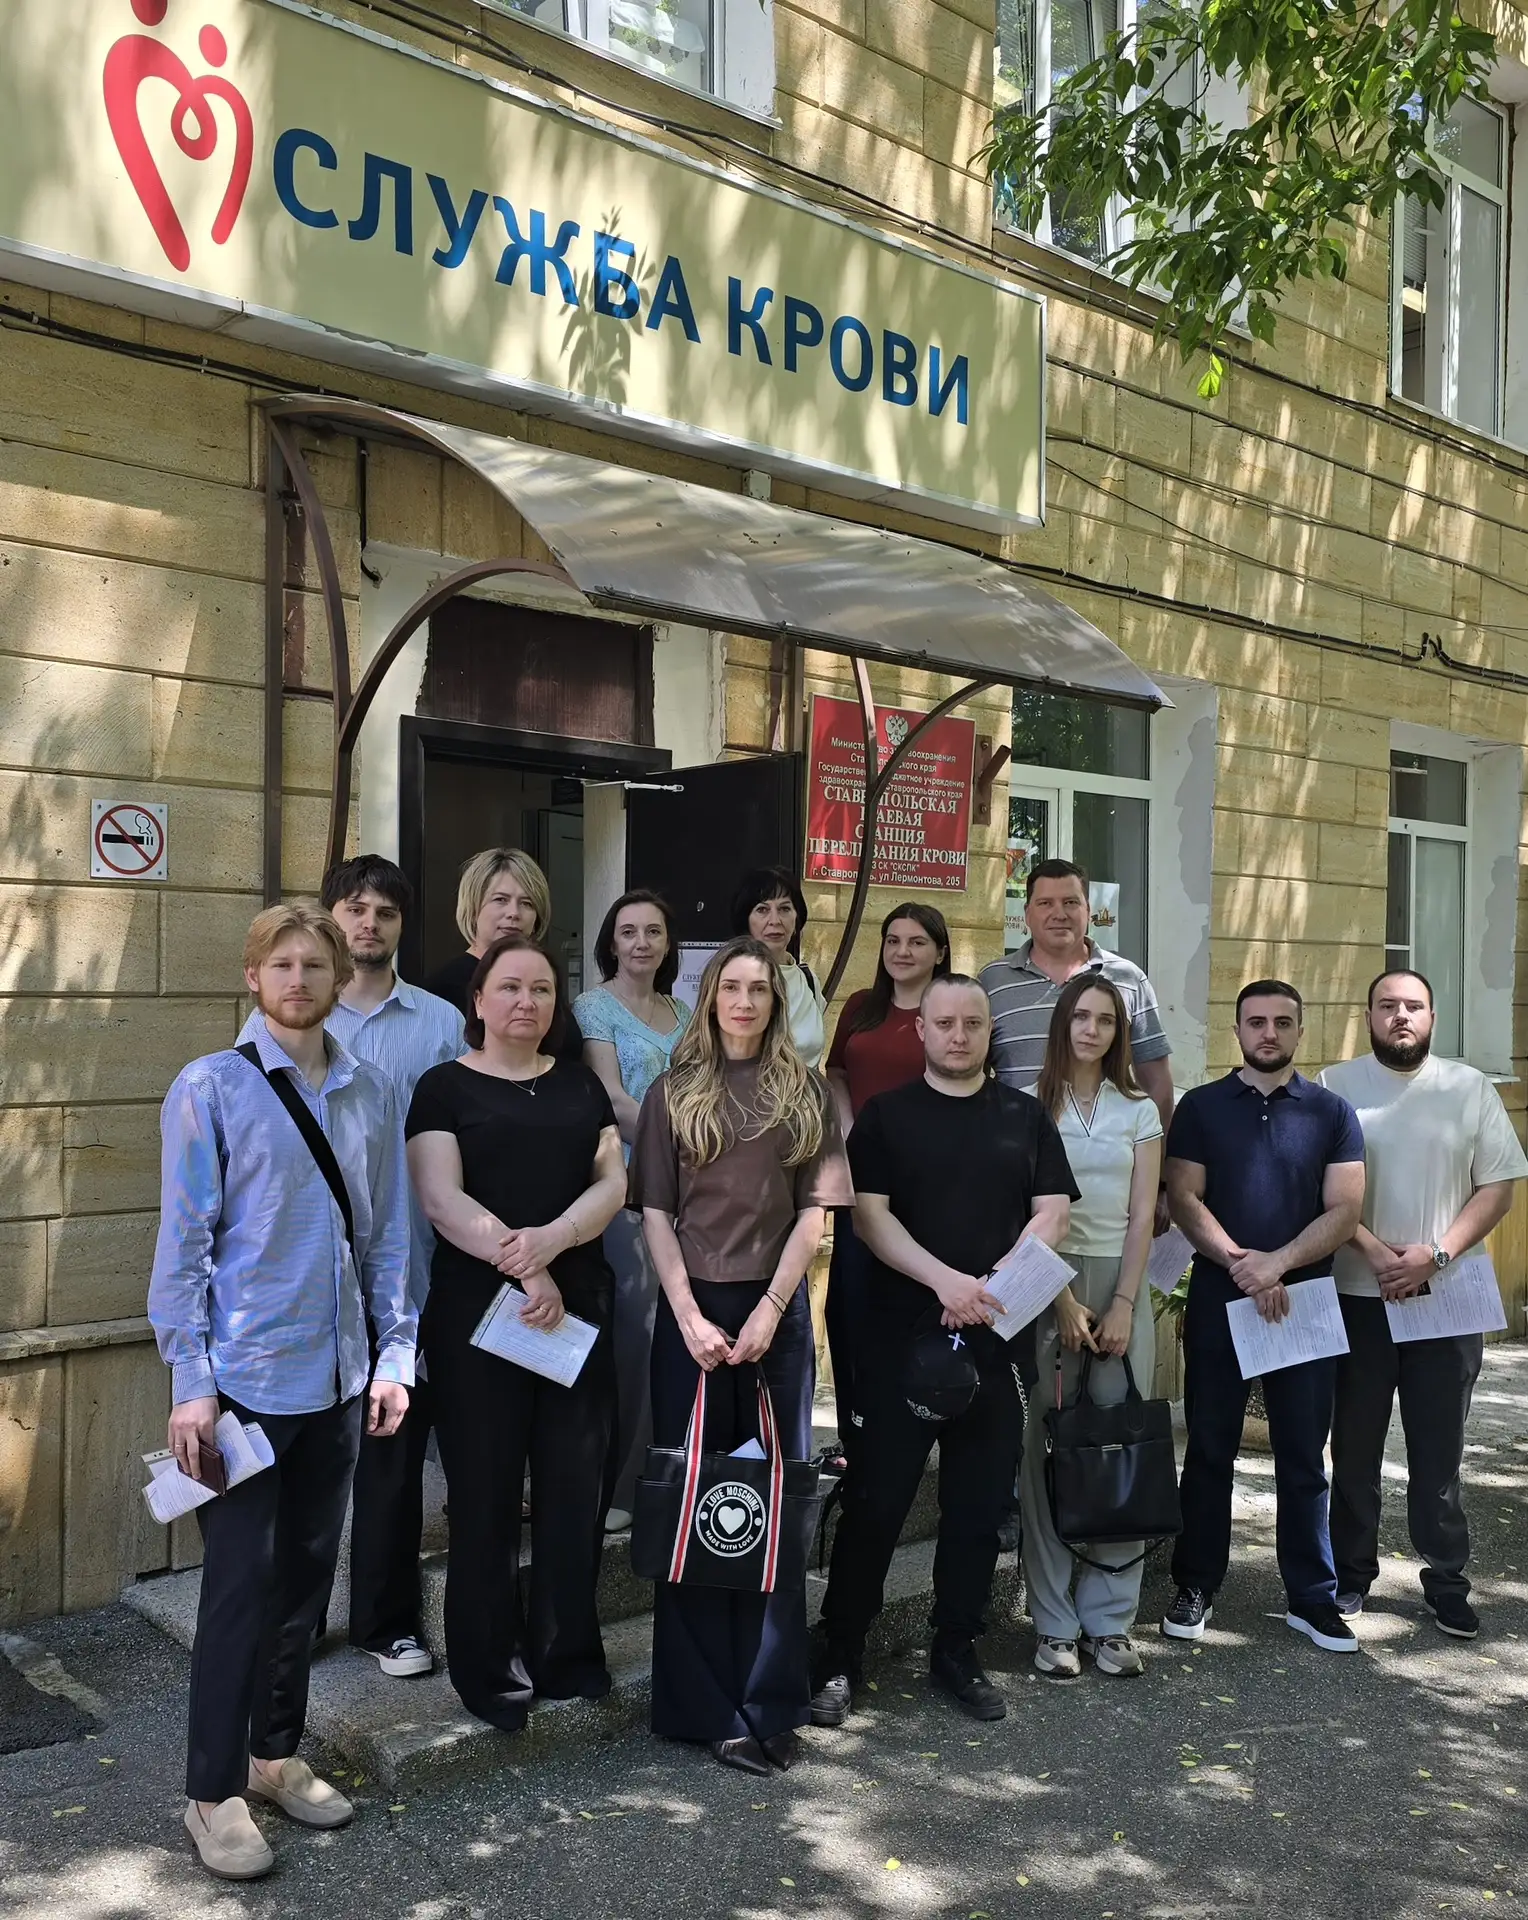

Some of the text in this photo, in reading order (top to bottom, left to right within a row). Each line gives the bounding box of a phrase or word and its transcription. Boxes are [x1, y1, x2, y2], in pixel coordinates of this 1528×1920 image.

[272, 128, 968, 425] СЛУЖБА КРОВИ
[919, 763, 937, 774] края
[923, 776, 965, 788] учреждение
[855, 823, 926, 845] САНЦИЯ
[878, 861, 888, 870] СК
[922, 848, 966, 866] КРОВИ
[812, 866, 960, 887] г. Ставропь, ул Лермонтова, 205
[706, 1486, 760, 1512] LOVE MOSCHINO
[705, 1530, 754, 1551] MADE WITH LOVE
